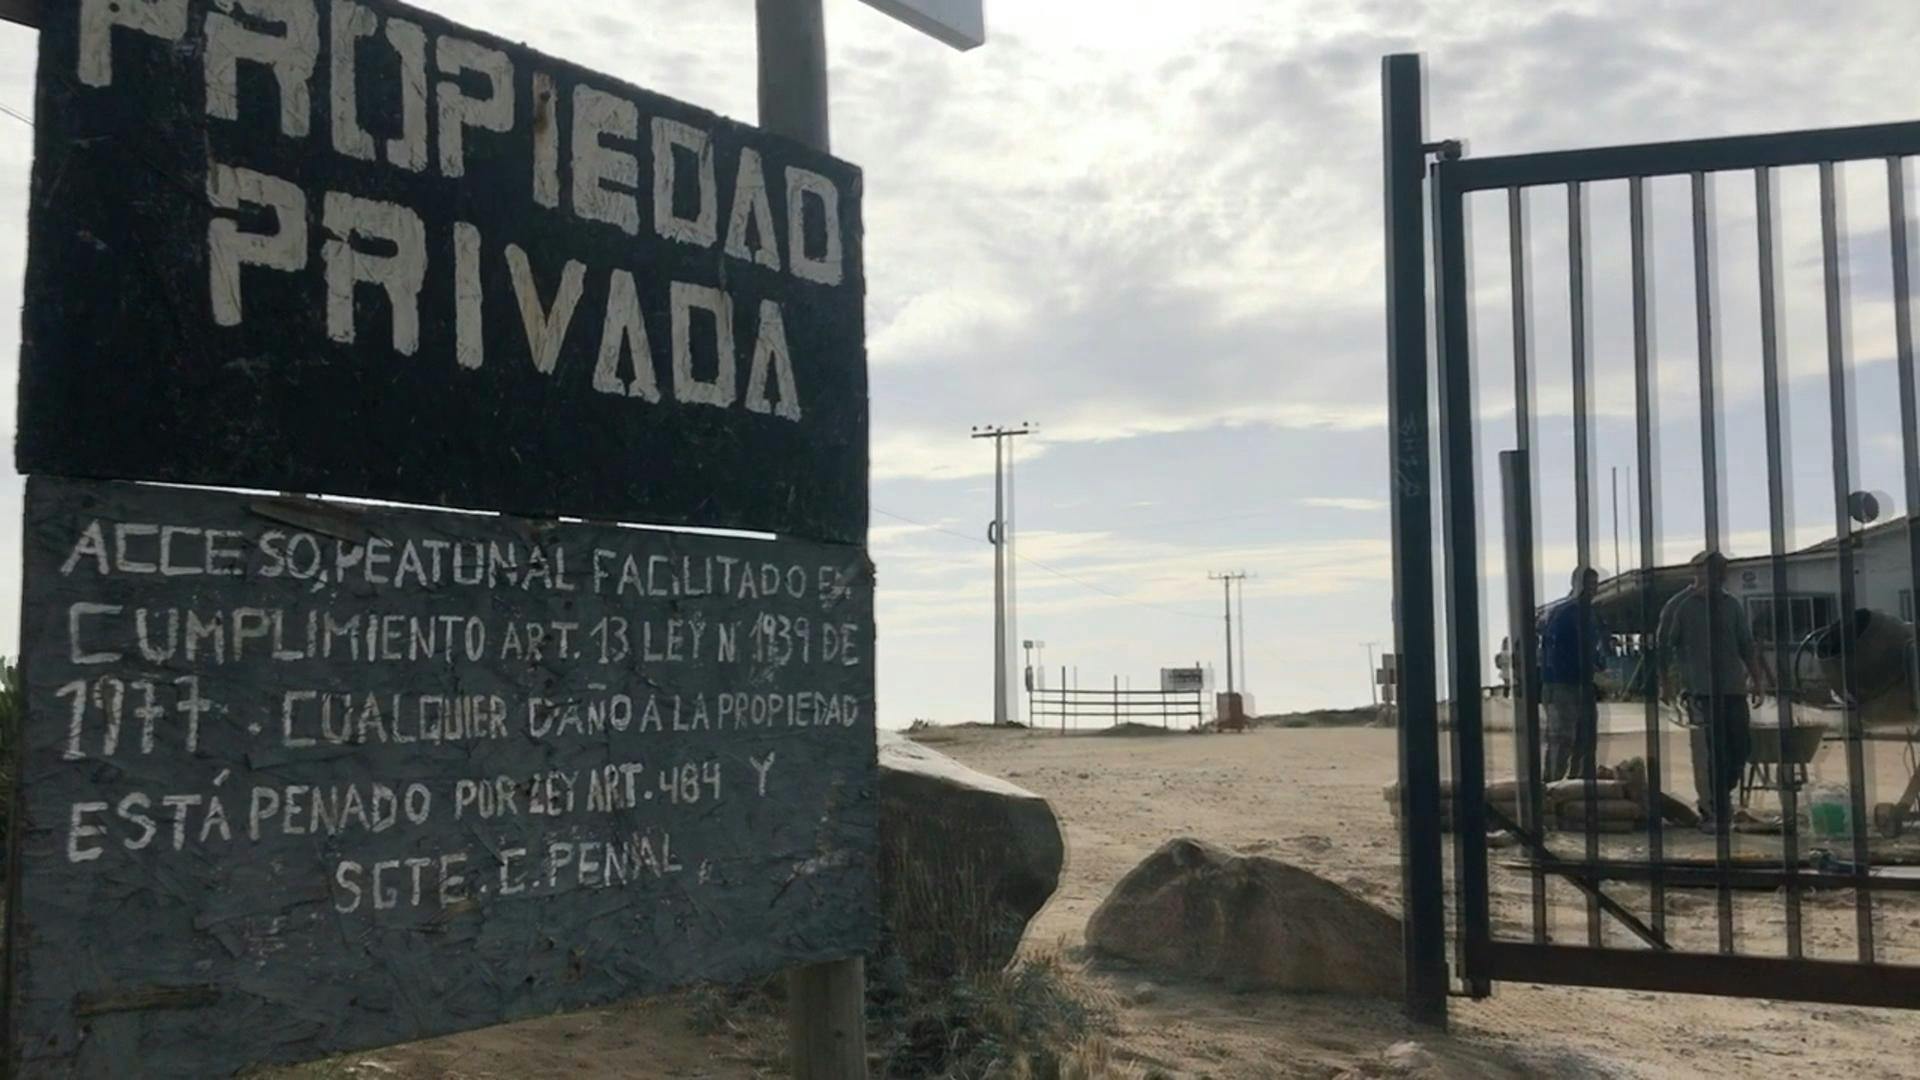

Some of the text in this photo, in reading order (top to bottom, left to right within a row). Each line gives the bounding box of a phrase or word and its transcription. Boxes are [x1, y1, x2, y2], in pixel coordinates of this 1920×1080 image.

[78, 0, 844, 284] PROPIEDAD
[208, 164, 801, 422] PRIVADA
[592, 549, 806, 599] FACILITADO
[69, 602, 486, 665] CUMPLIMIENTO
[501, 622, 580, 661] ART.
[590, 616, 629, 664] 13
[643, 615, 706, 662] LEY
[822, 622, 859, 666] DE
[282, 690, 508, 746] CUALQUIER
[528, 682, 632, 738] DAÑO
[640, 694, 664, 733] A
[673, 697, 710, 732] LA
[718, 691, 858, 730] PROPIEDAD
[67, 769, 232, 863] ESTÁ
[249, 783, 432, 841] PENADO
[454, 774, 518, 820] POR
[529, 770, 578, 816] LEY
[586, 762, 653, 813] ART.
[750, 751, 775, 796] Y
[548, 833, 683, 889] PENAL
